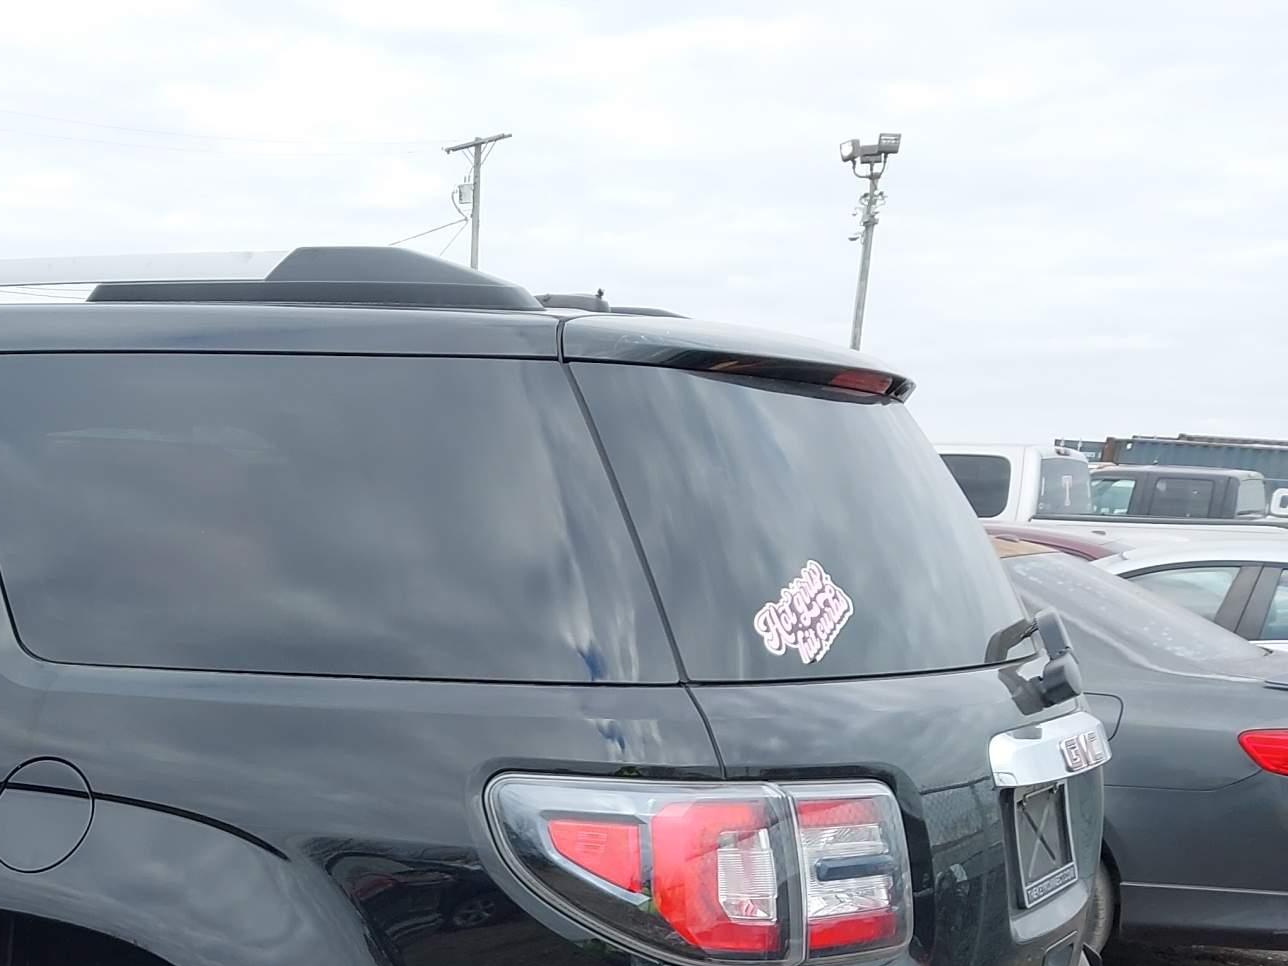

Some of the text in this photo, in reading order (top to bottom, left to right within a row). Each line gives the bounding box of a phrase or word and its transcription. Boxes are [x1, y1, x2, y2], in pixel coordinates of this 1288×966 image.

[756, 565, 824, 650] Hot girls
[797, 586, 848, 663] hit curbs
